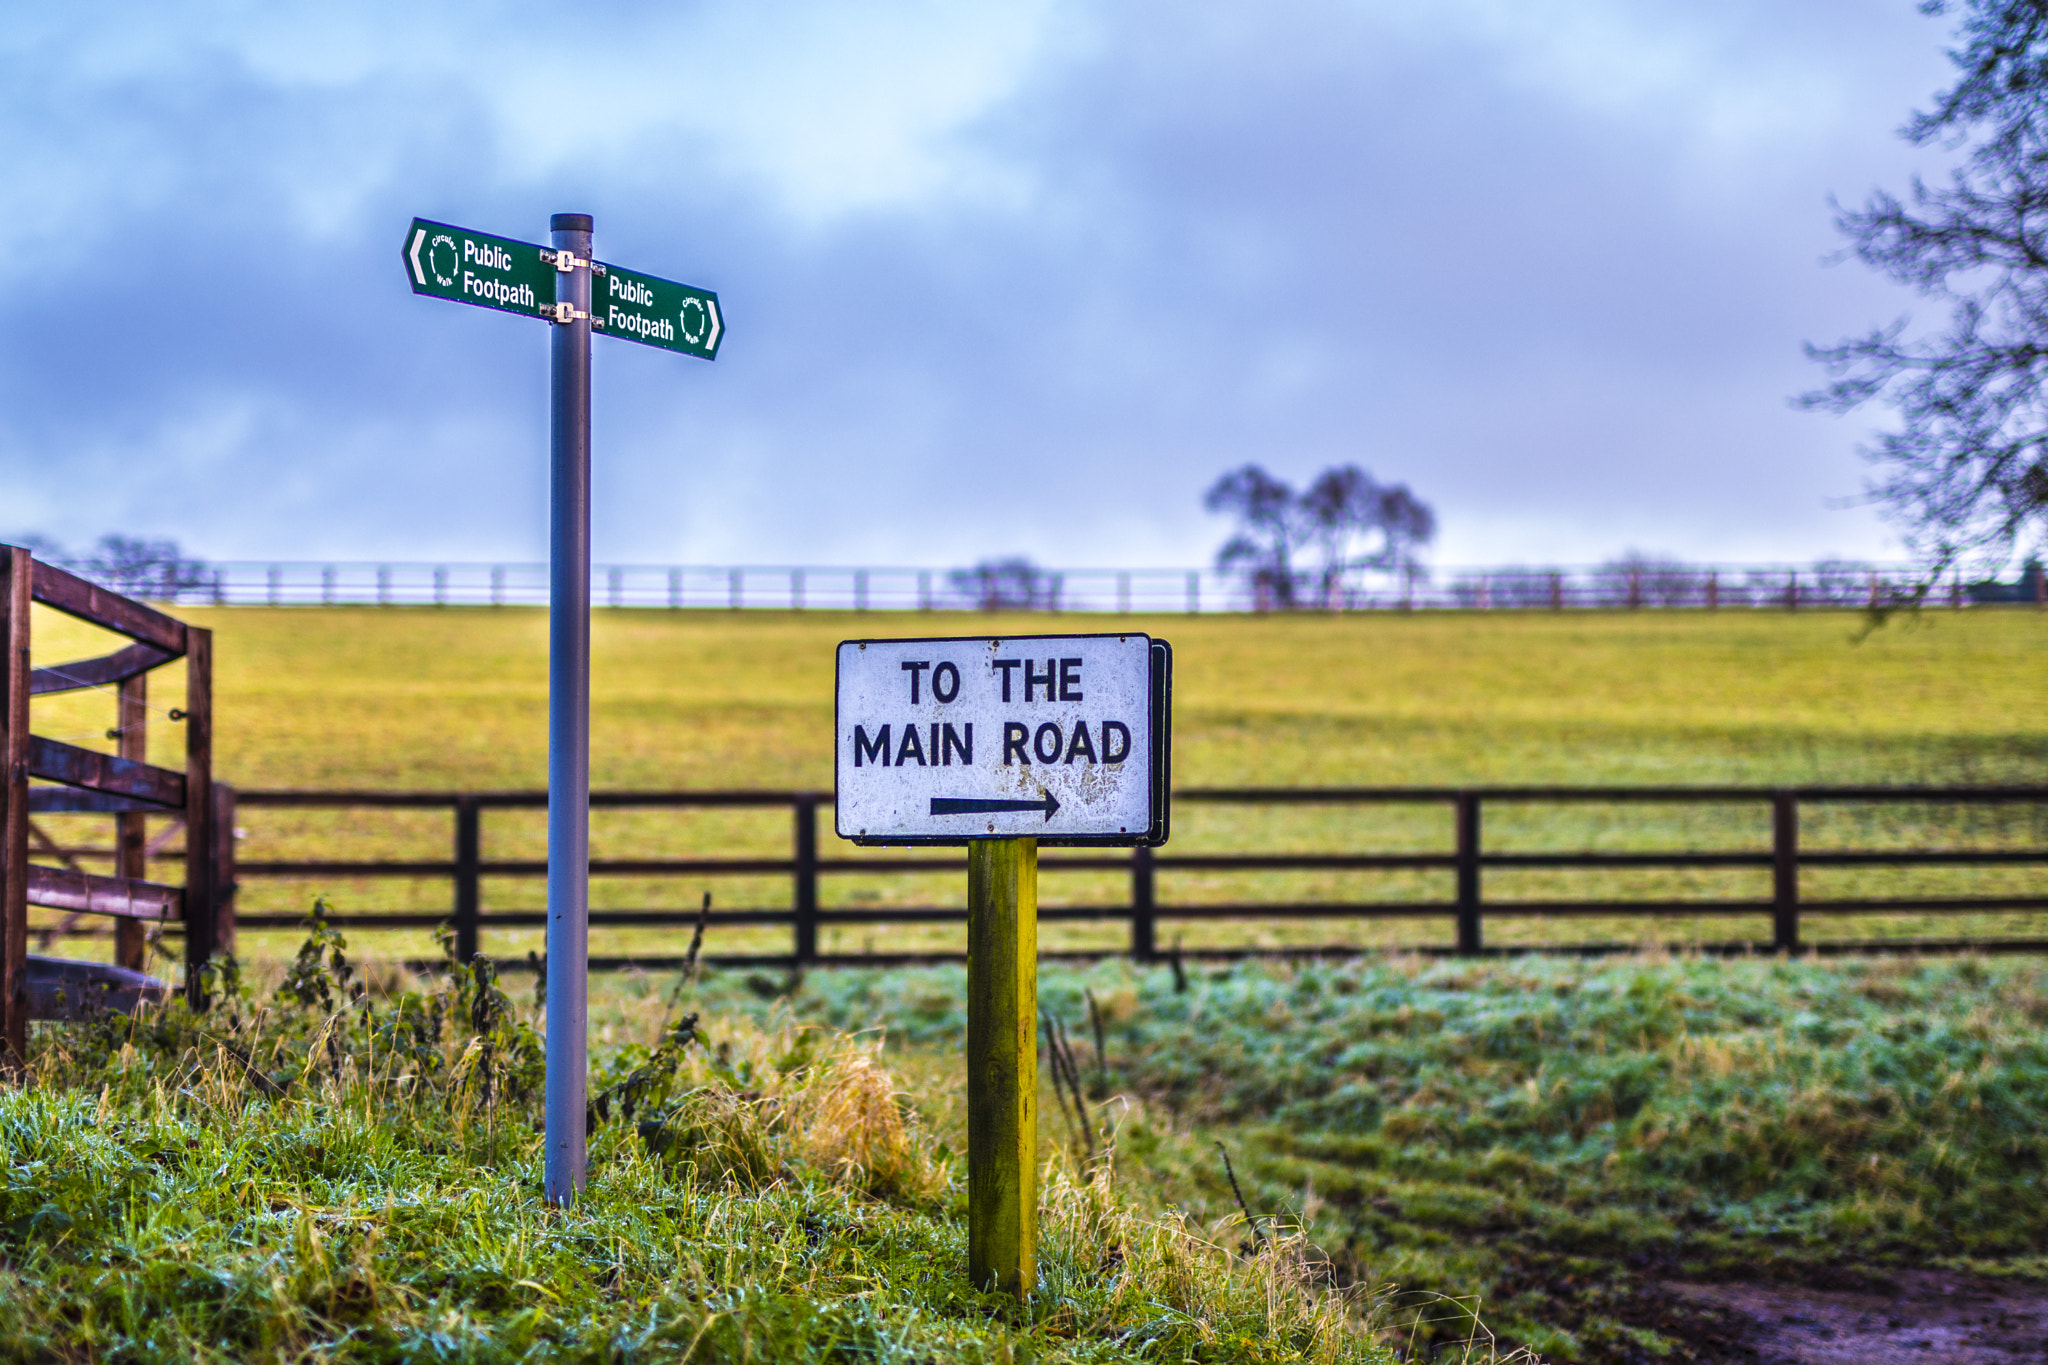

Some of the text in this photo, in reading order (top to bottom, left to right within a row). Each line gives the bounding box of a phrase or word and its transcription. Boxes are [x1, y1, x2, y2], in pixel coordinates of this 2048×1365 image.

[431, 234, 457, 251] Circular
[464, 239, 512, 271] Public
[436, 273, 453, 287] Walk
[463, 270, 535, 308] Footpath
[609, 275, 653, 307] Public
[608, 304, 674, 341] Footpath
[901, 658, 1083, 704] TO THE
[854, 720, 1132, 767] MAIN ROAD
